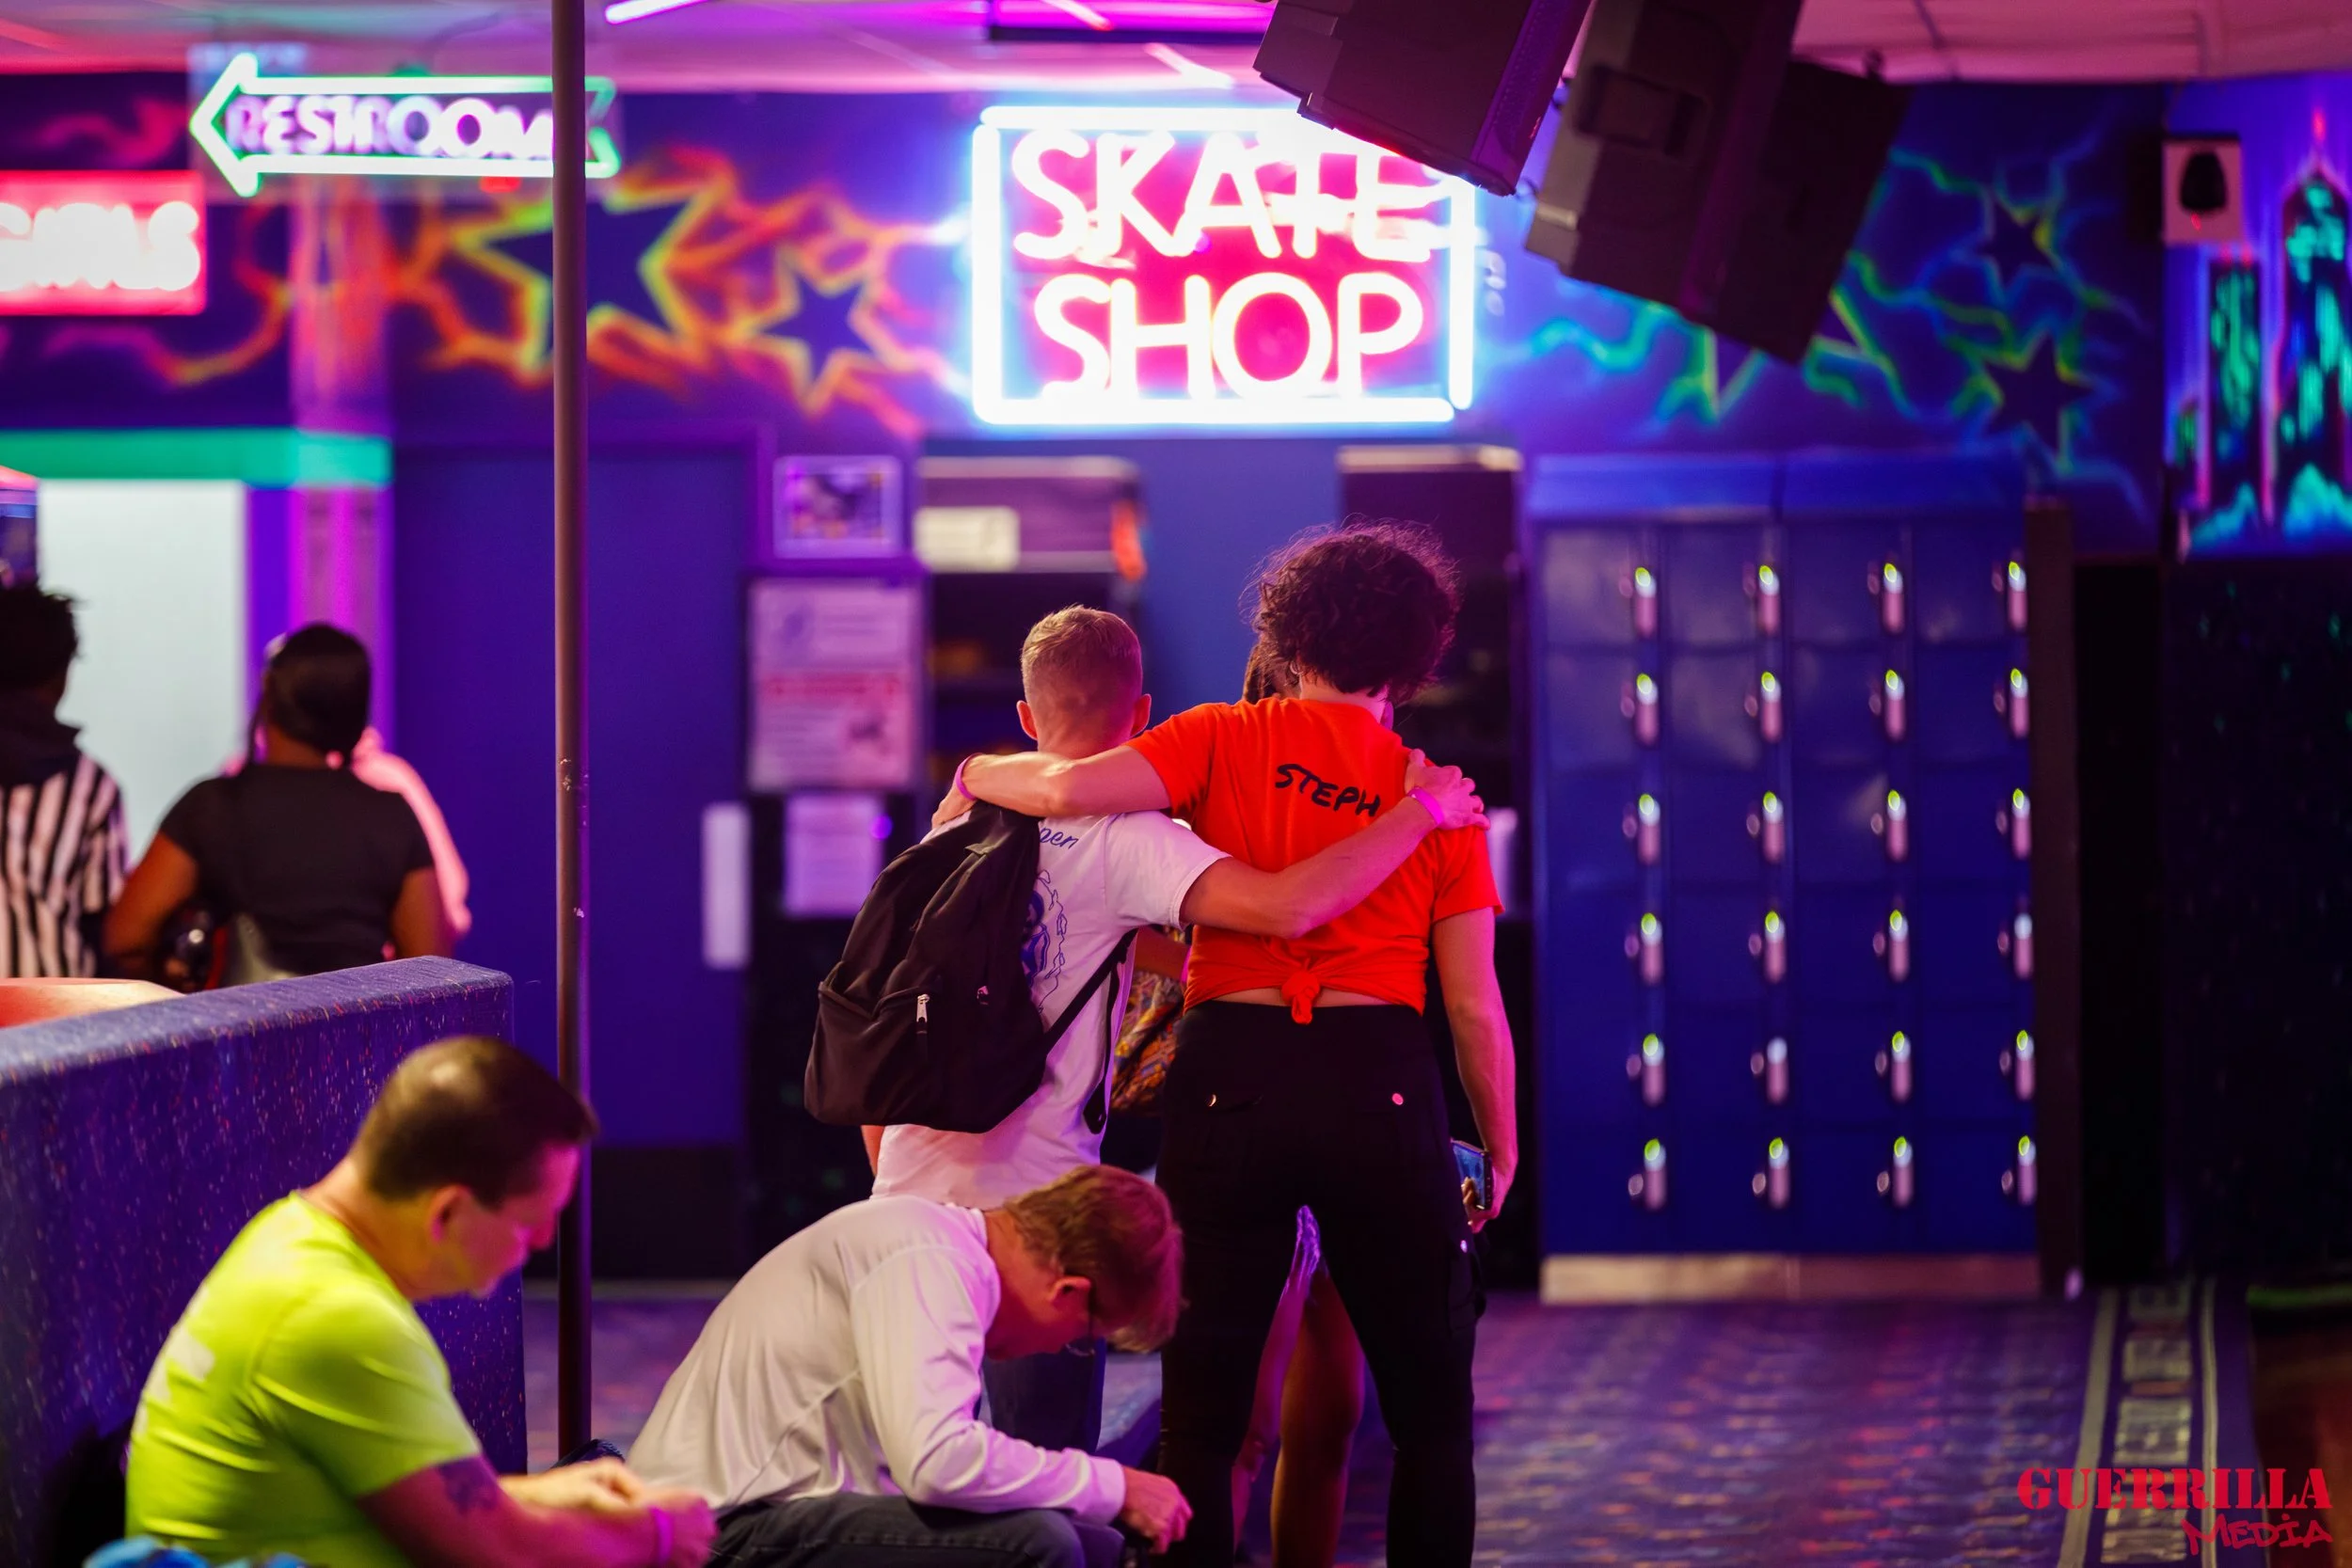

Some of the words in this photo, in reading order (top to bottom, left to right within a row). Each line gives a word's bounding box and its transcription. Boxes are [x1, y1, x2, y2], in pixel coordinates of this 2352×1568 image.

[1012, 130, 1432, 262] SKATE
[1035, 273, 1423, 401] SHOP
[1275, 763, 1381, 817] STEPH
